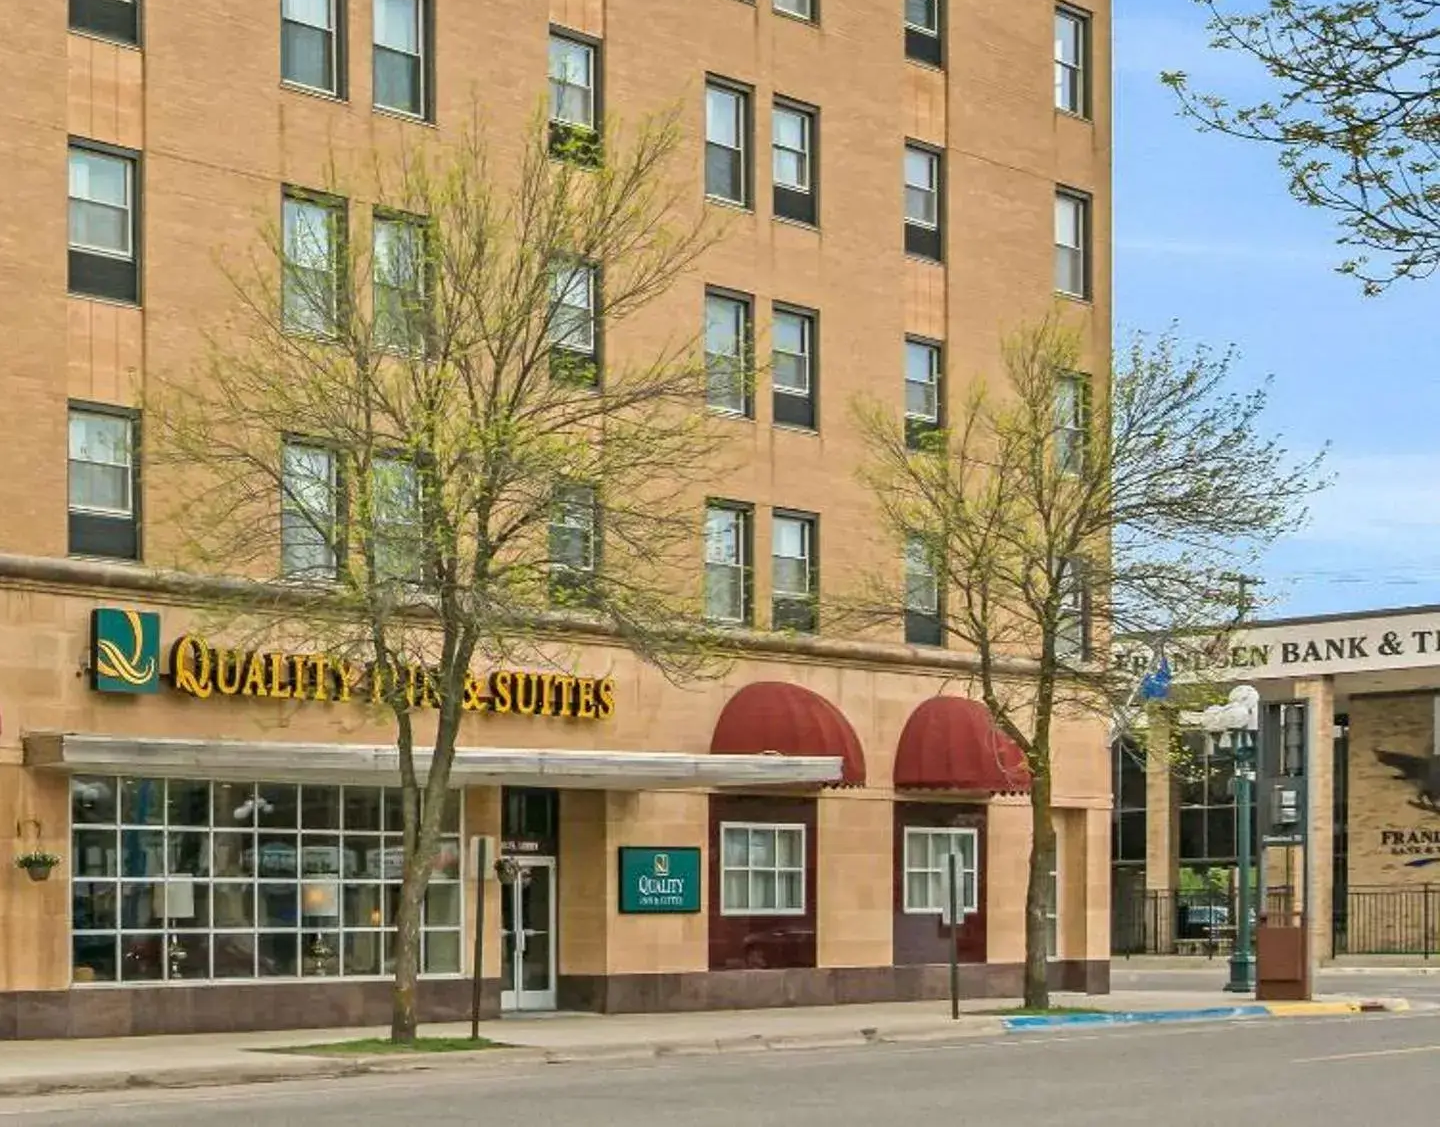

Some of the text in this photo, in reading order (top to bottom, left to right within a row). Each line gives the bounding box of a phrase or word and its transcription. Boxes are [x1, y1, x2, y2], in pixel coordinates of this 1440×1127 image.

[1281, 636, 1369, 664] BANK
[1378, 630, 1405, 656] &
[1412, 630, 1440, 654] T
[170, 635, 353, 702] QUALITY
[490, 670, 616, 719] SUITES
[639, 875, 684, 895] QUALITY
